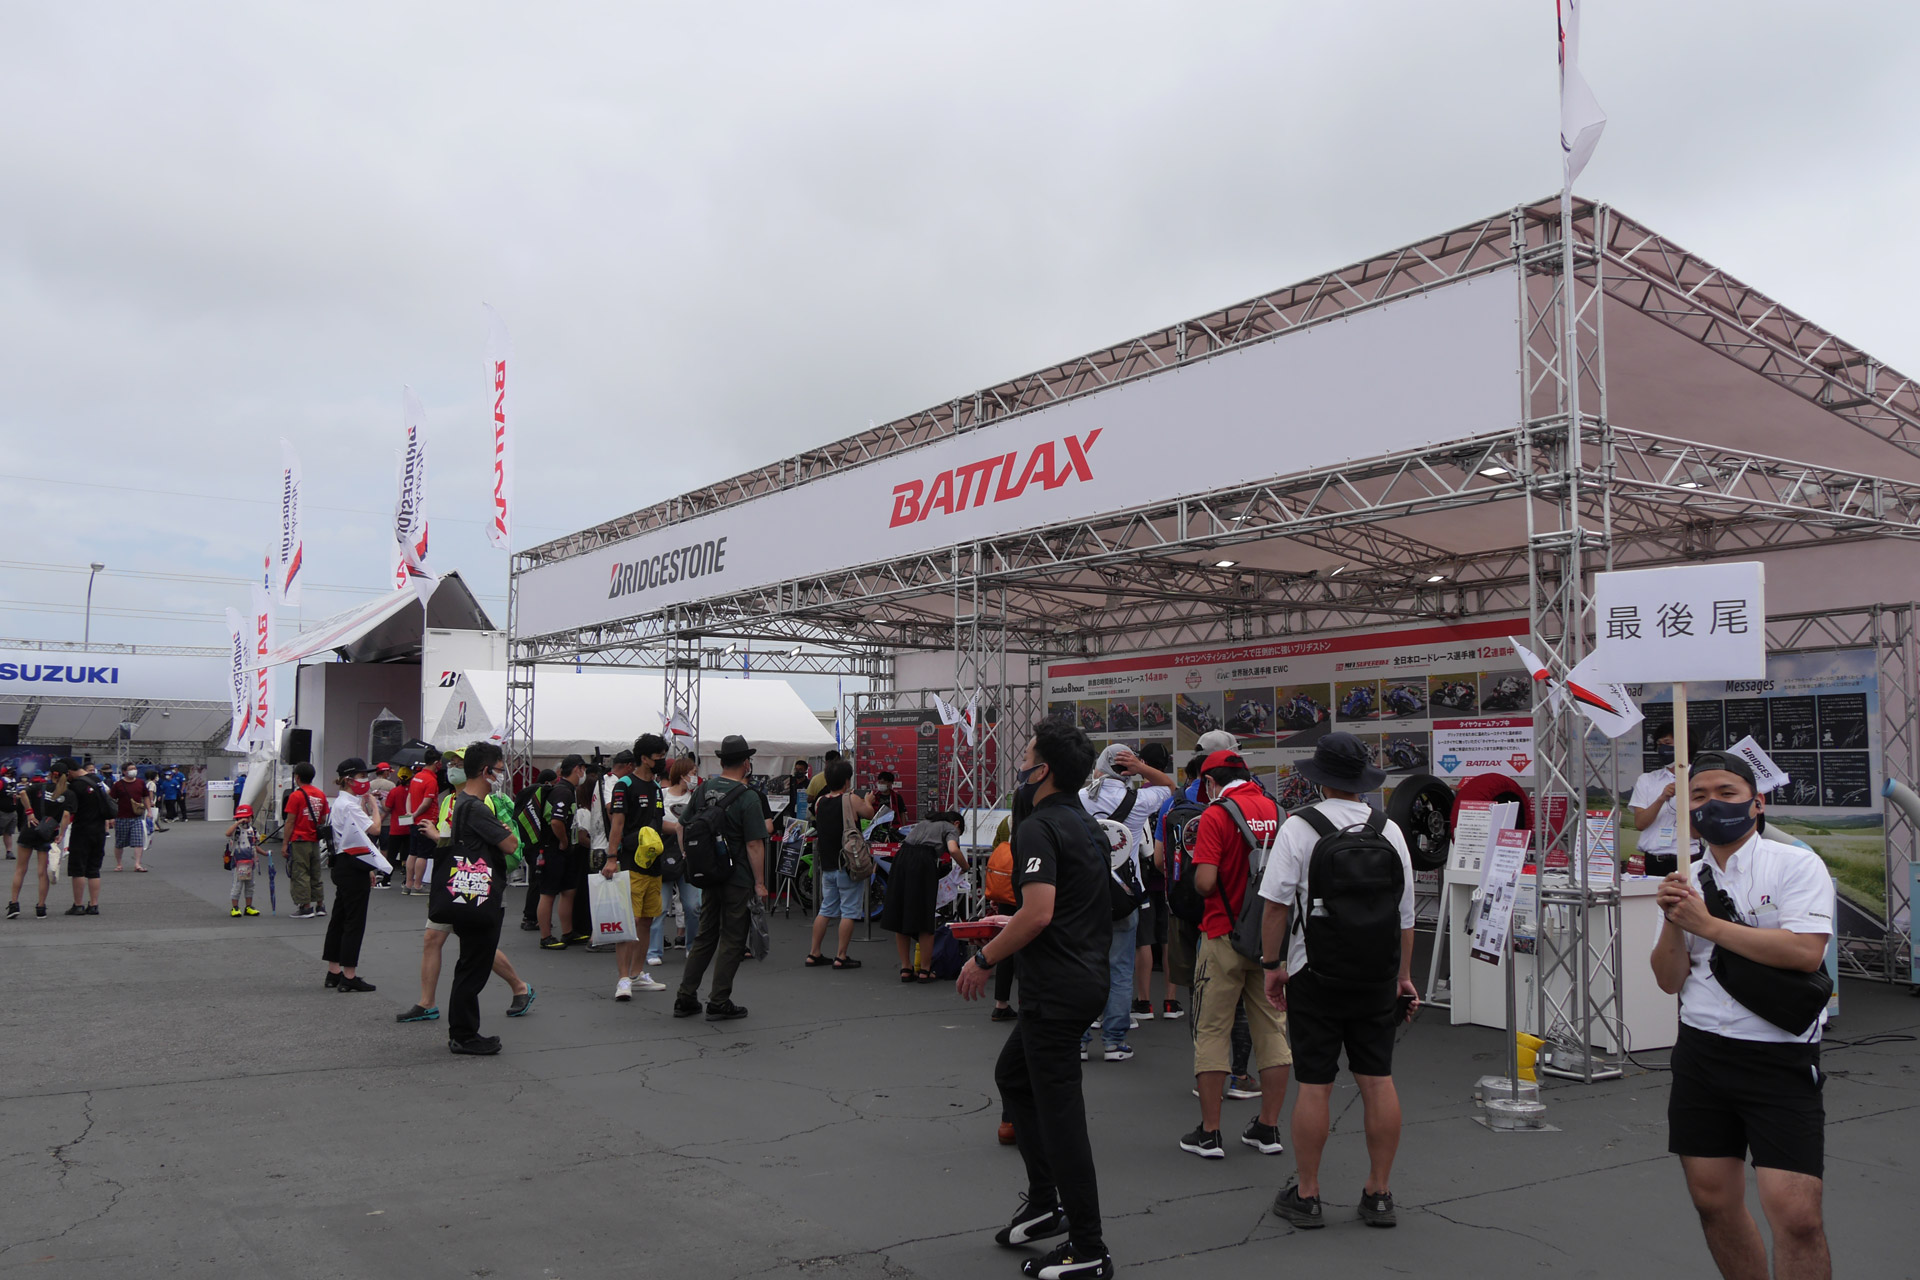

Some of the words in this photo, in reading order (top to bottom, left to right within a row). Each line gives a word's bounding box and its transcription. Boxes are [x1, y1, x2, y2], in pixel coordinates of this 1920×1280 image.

[889, 428, 1103, 528] BATTLAX
[608, 536, 727, 599] BRIDGESTONE
[1606, 599, 1748, 640] 最後尾
[0, 663, 119, 684] SUZUKI
[1273, 665, 1289, 674] EWC
[1067, 682, 1072, 693] 8
[1072, 683, 1085, 693] hours
[1626, 684, 1643, 697] oad
[1725, 679, 1775, 693] Messages
[1247, 818, 1278, 832] stem
[455, 870, 489, 882] MUSIC
[452, 880, 469, 889] FES
[600, 921, 624, 933] RK
